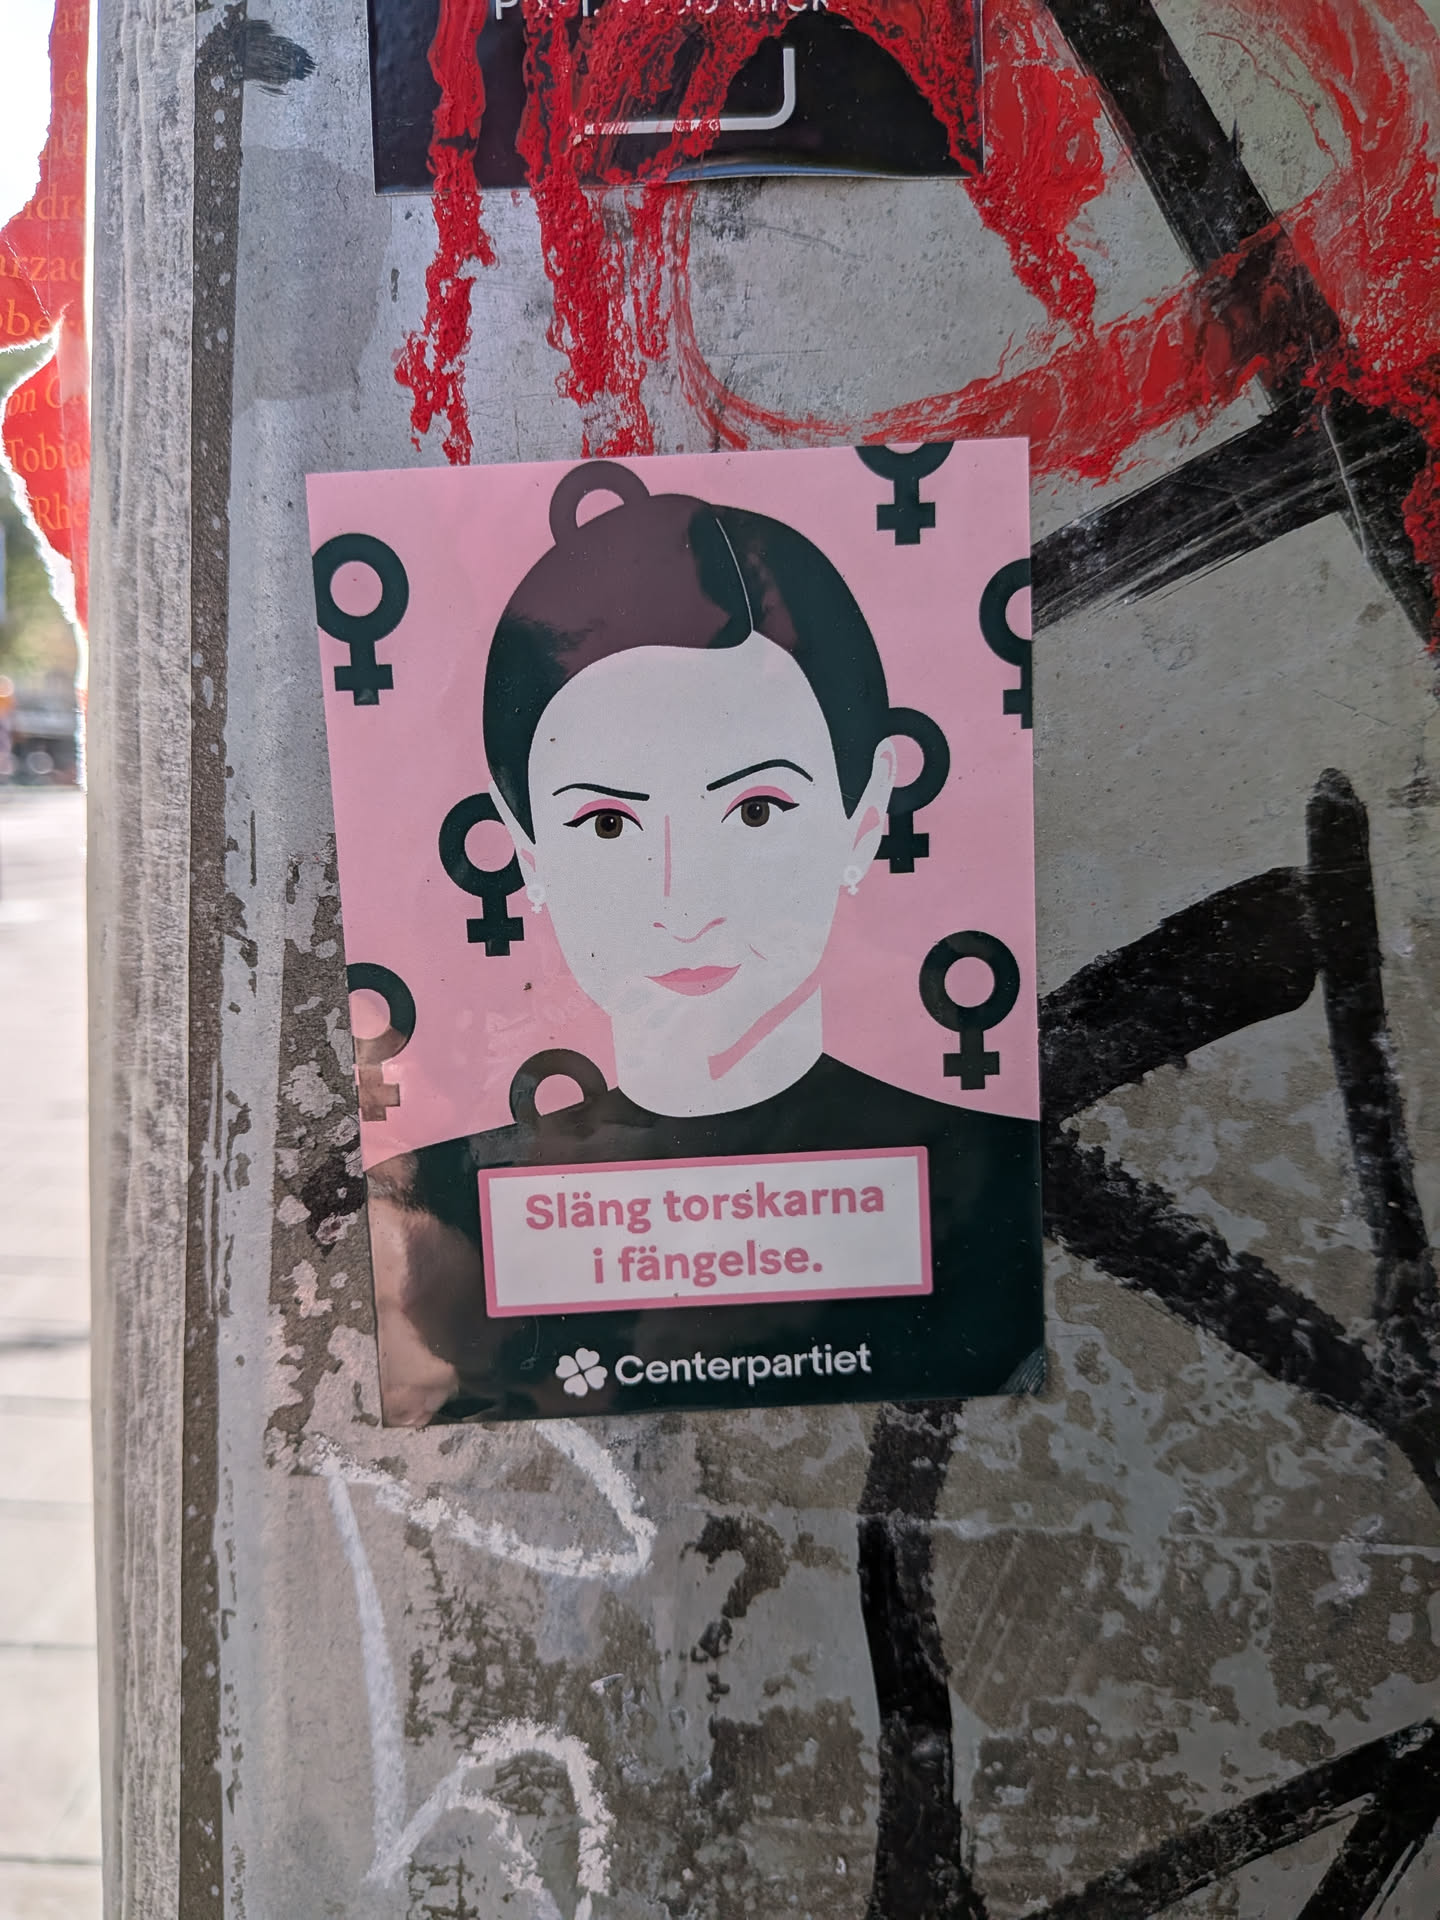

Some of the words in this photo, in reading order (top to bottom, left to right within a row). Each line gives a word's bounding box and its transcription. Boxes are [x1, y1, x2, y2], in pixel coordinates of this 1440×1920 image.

[525, 1191, 652, 1234] Släng
[663, 1181, 885, 1222] torskarna
[593, 1247, 604, 1284] i
[618, 1239, 823, 1287] fängelse.
[614, 1342, 872, 1386] Centerpartiet
